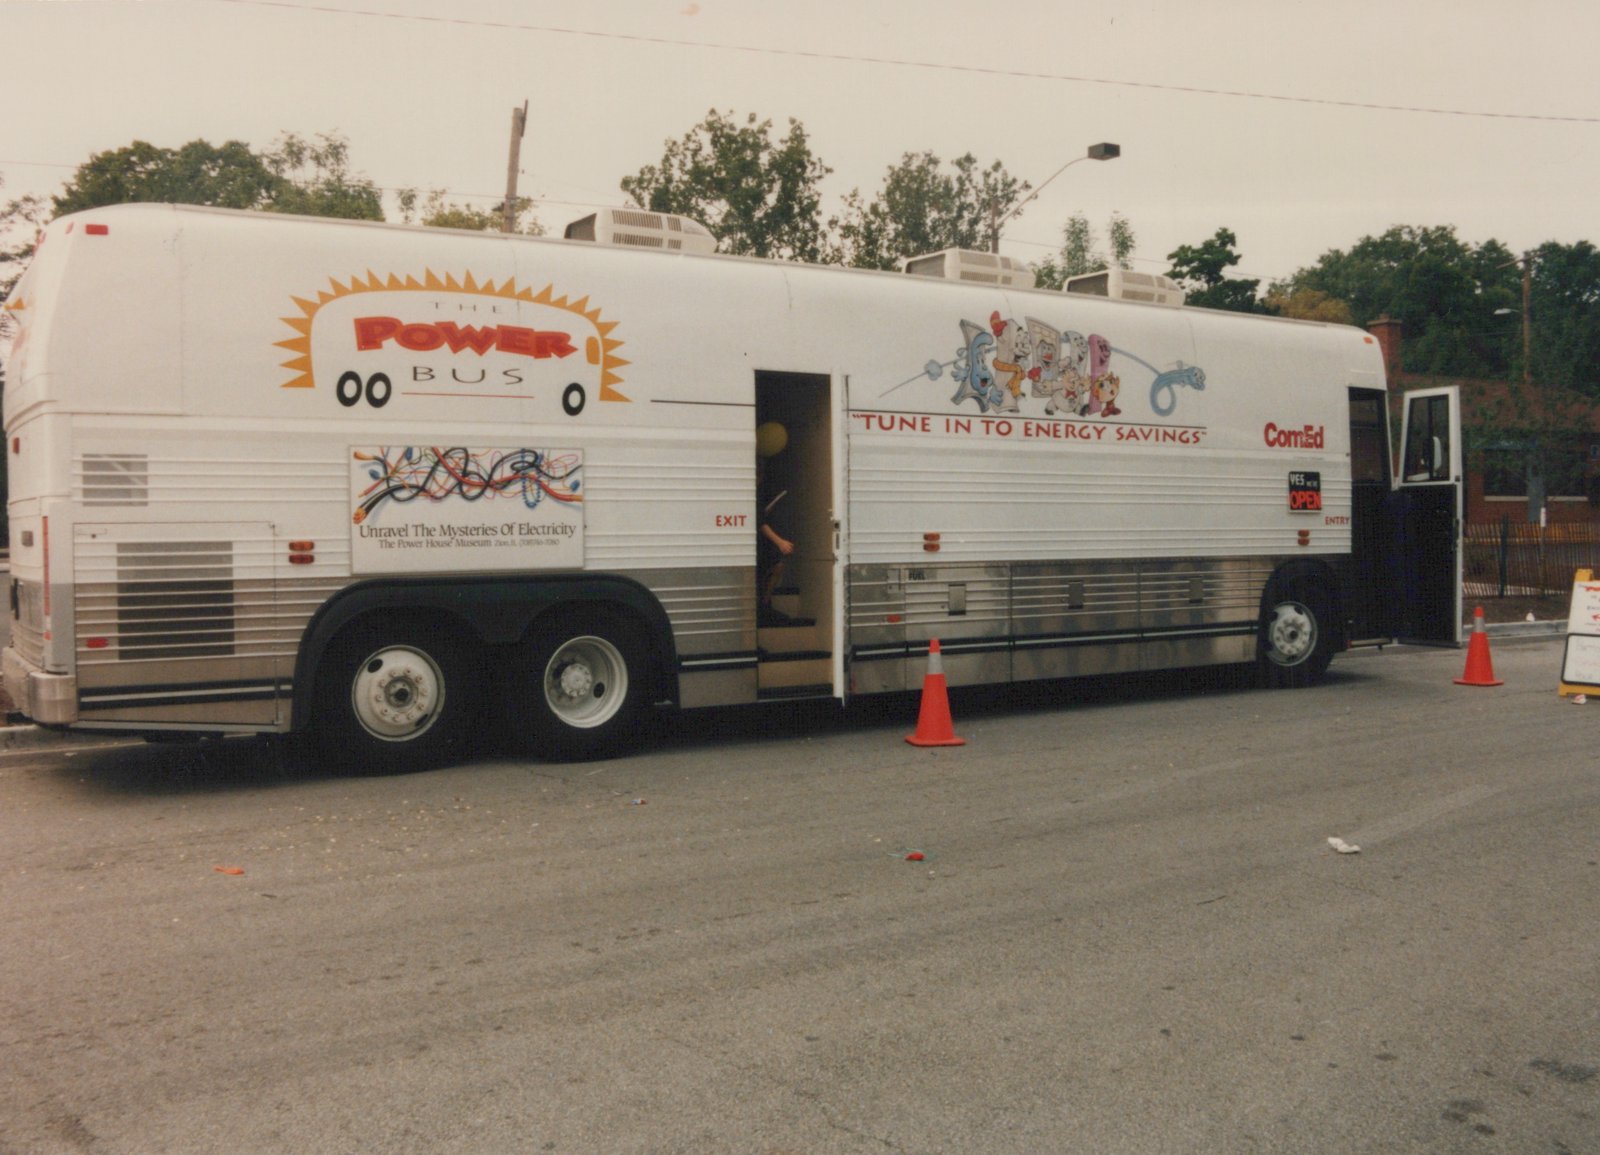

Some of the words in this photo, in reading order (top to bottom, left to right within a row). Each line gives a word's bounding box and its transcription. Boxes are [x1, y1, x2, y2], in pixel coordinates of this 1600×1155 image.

[428, 301, 503, 314] THE
[354, 316, 579, 359] POWER
[412, 366, 524, 385] BUS
[945, 418, 971, 434] IN
[980, 420, 1013, 436] TO
[1023, 421, 1107, 440] ENERGY
[1263, 422, 1325, 449] ComEd
[1290, 473, 1305, 486] YES
[1288, 491, 1322, 509] OPEN
[716, 515, 747, 527] EXIT
[1325, 516, 1350, 526] ENTRY
[360, 523, 409, 538] Unravel
[412, 523, 436, 537] The
[440, 523, 498, 540] Mysteries
[500, 522, 516, 536] Of
[518, 522, 577, 539] Electricity
[379, 539, 395, 549] The
[398, 539, 423, 549] Power
[426, 538, 452, 548] House
[455, 538, 492, 548] Museum
